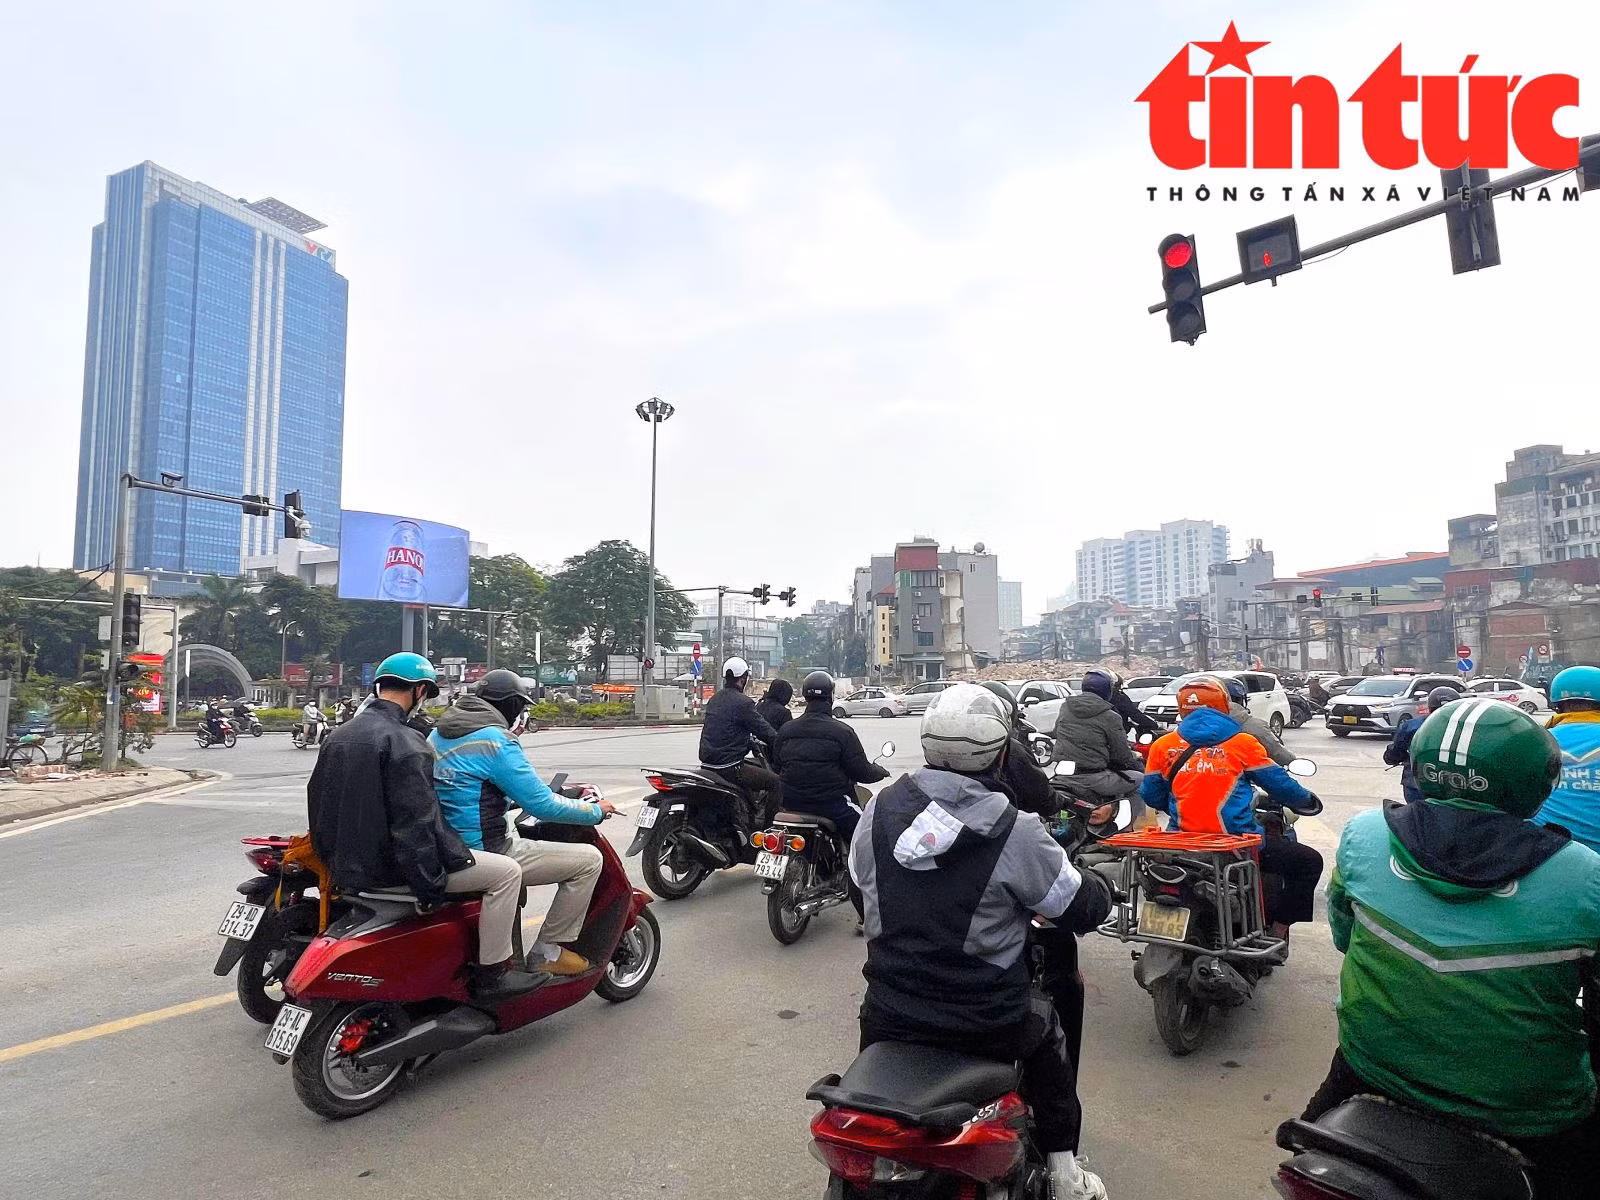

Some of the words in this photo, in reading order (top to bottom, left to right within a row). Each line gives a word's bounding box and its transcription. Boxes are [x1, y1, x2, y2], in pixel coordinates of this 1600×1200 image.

[1422, 762, 1489, 792] Grab
[1561, 768, 1590, 779] NH
[230, 904, 259, 922] 29-AD
[220, 919, 255, 938] 314.37
[277, 1008, 306, 1032] 29-AC
[266, 1027, 298, 1053] 615.69
